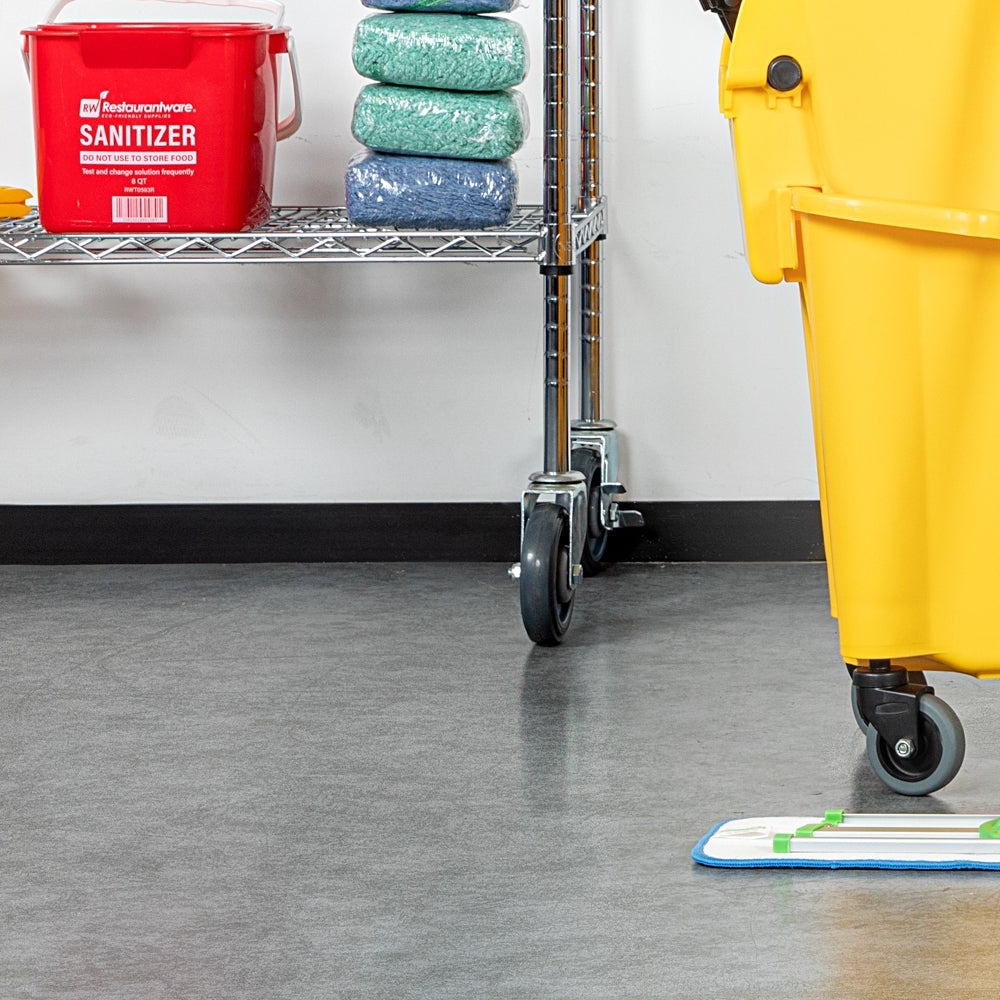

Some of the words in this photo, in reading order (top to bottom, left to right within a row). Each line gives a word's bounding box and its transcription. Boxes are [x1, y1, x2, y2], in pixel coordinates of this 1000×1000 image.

[83, 100, 99, 113] RW
[80, 124, 196, 146] SANITIZER
[82, 154, 94, 162] DO
[96, 154, 112, 162] NOT
[114, 154, 129, 162] USE
[131, 154, 142, 162] TO
[144, 154, 169, 162] STORE
[170, 154, 194, 162] FOOD
[109, 168, 133, 176] change
[161, 168, 195, 176] frequently
